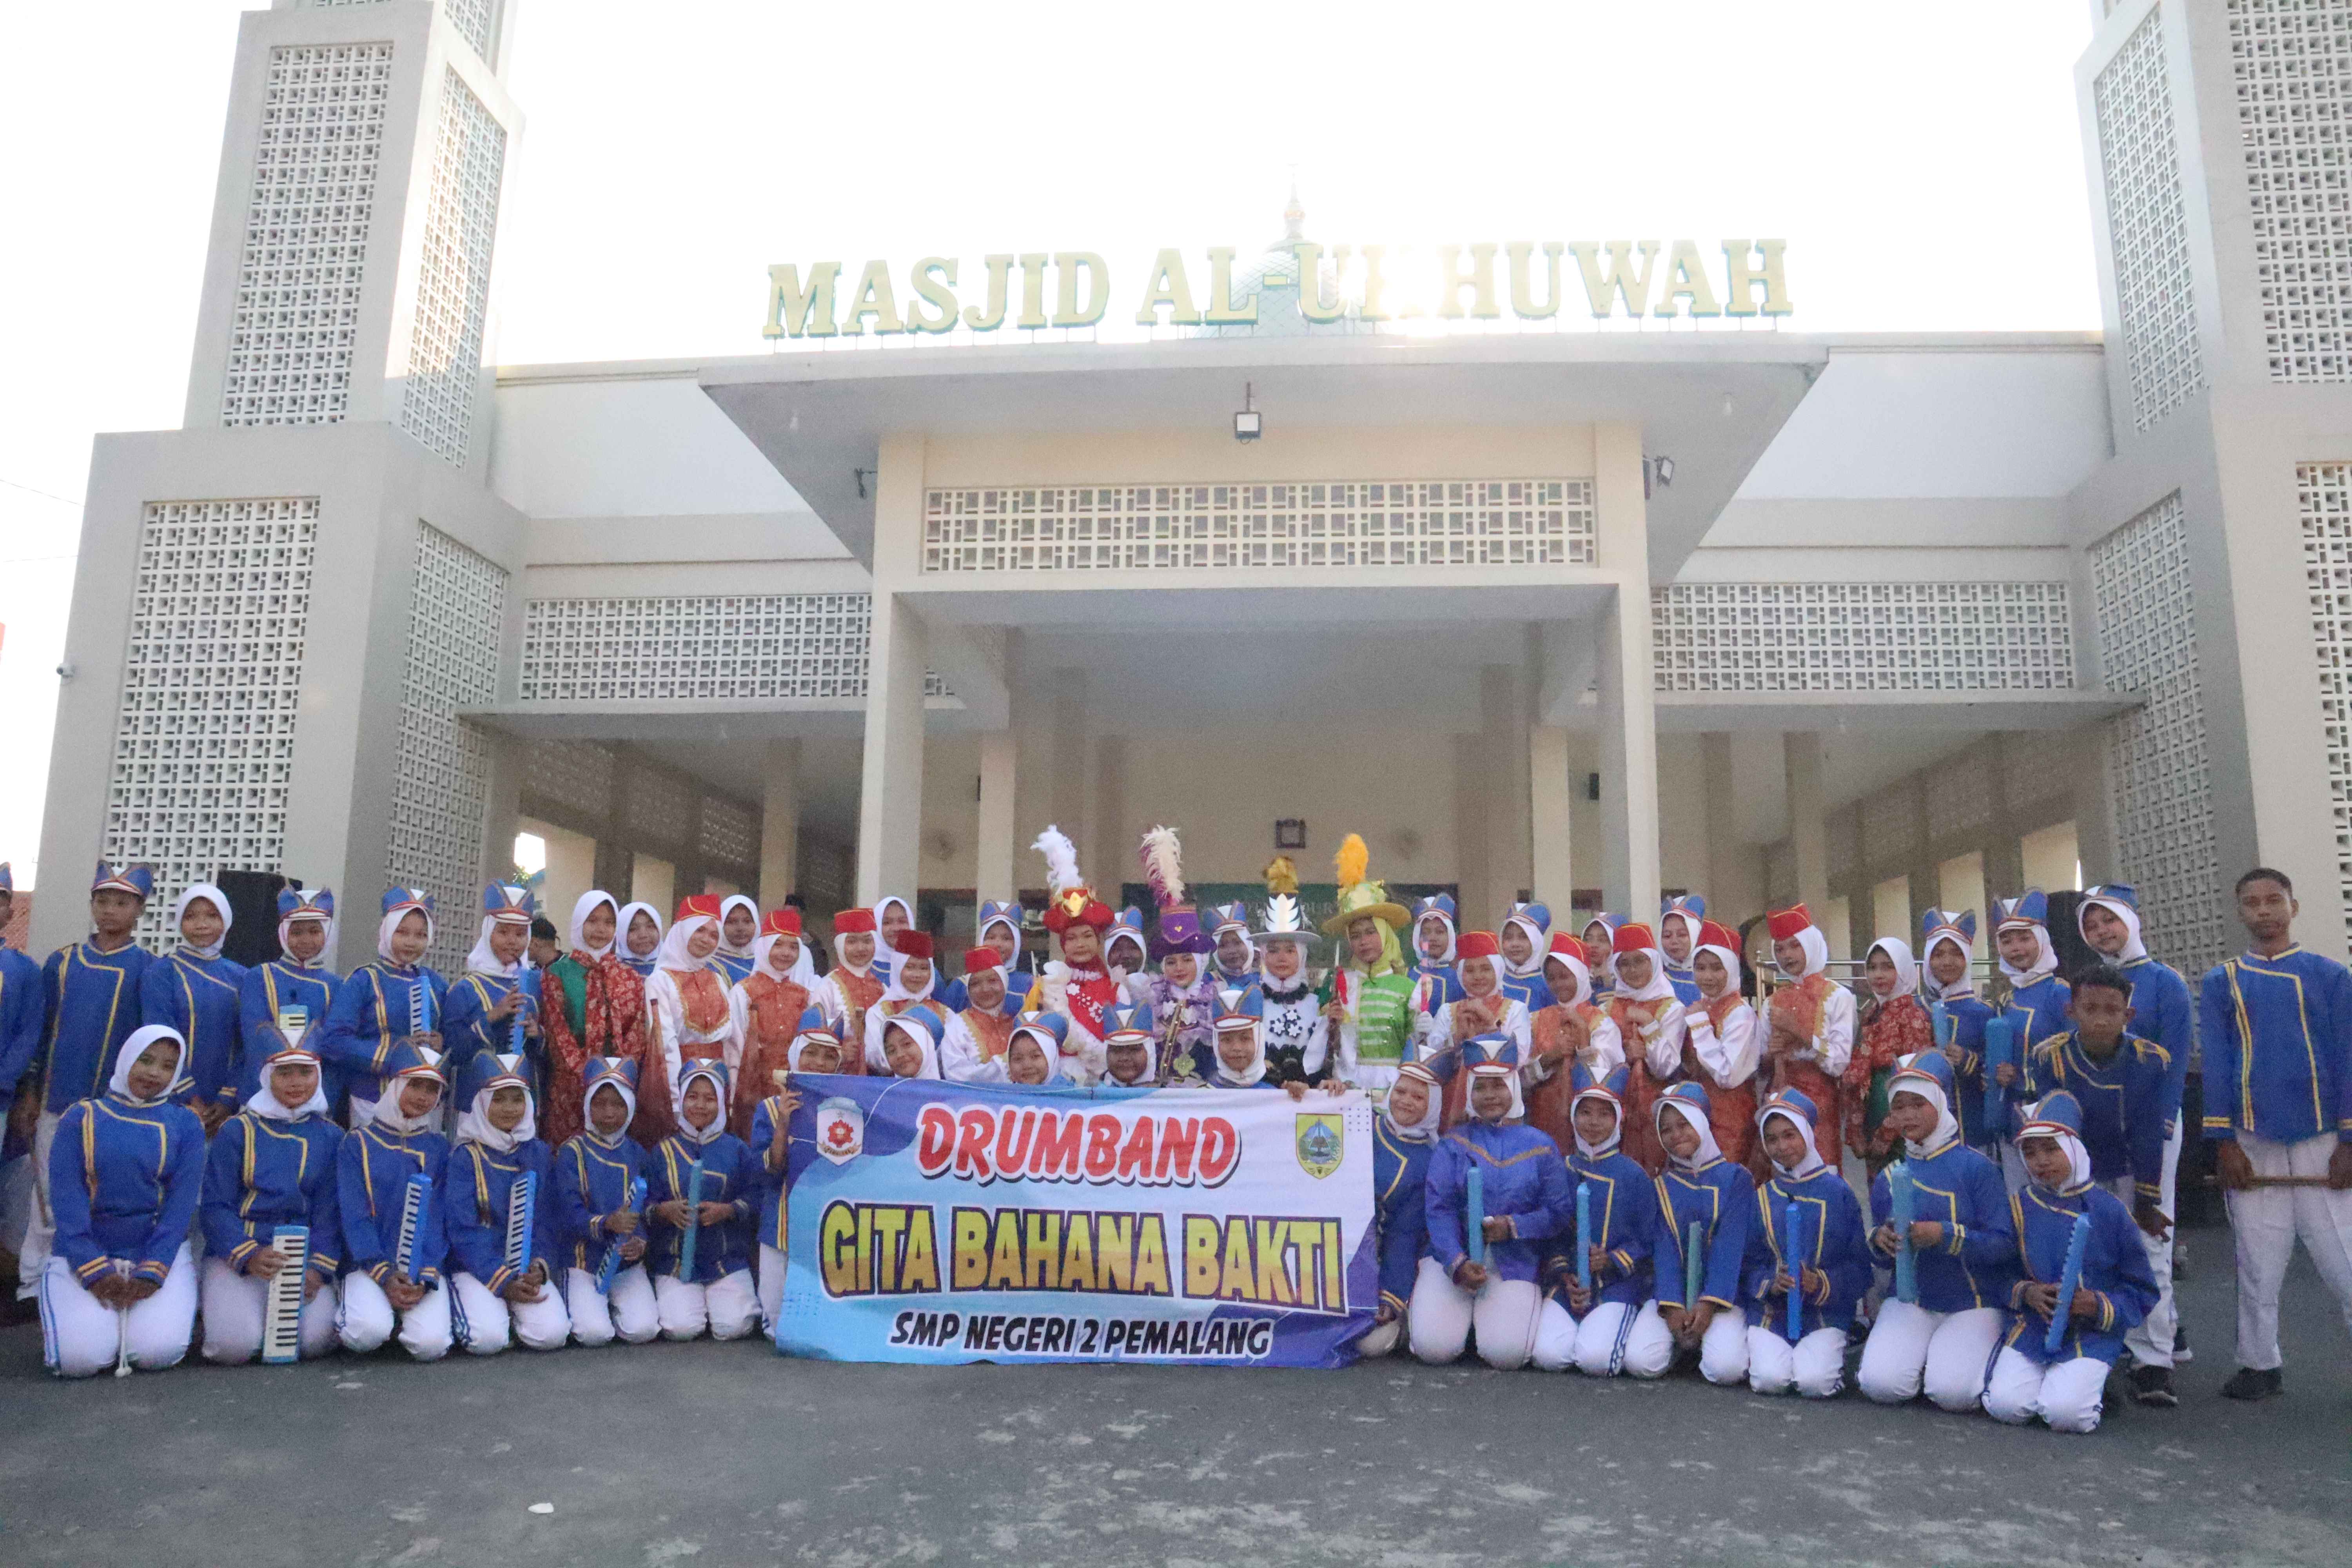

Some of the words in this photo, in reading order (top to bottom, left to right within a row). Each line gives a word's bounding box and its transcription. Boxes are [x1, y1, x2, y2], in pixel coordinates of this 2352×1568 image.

[762, 251, 1110, 338] MASJID
[918, 1107, 1237, 1180] DRUMBAND
[819, 1200, 942, 1298] GITA
[950, 1206, 1174, 1298] BAHANA
[1182, 1213, 1345, 1313] BAKTI
[890, 1312, 960, 1347] SMP
[964, 1316, 1076, 1353] NEGERI
[1079, 1319, 1099, 1352] 2
[1104, 1320, 1271, 1356] PEMALANG
